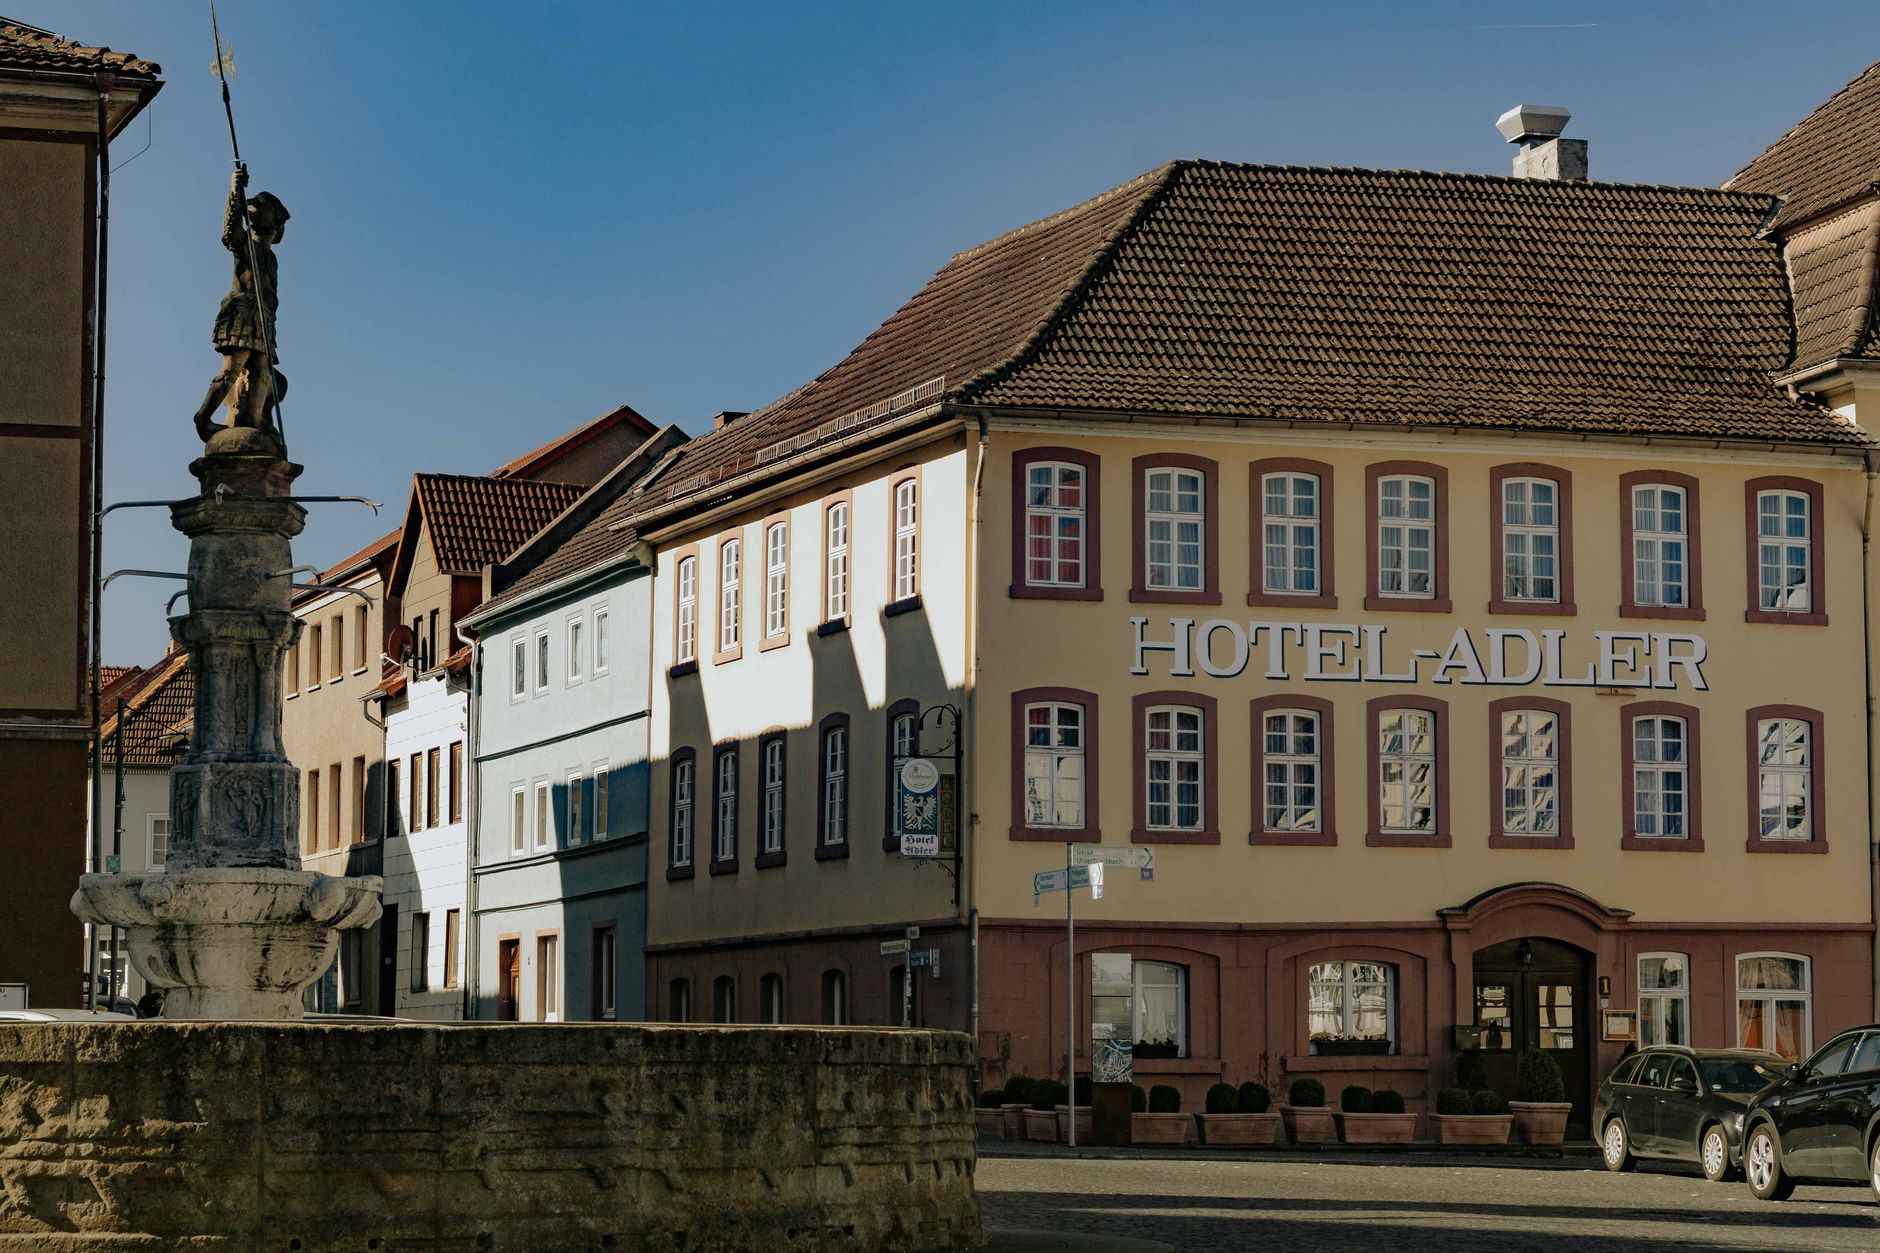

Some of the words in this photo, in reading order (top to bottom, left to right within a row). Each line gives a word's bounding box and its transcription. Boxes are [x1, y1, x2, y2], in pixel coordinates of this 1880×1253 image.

[905, 835, 934, 844] Hotel
[904, 845, 934, 855] Adler
[1602, 978, 1609, 993] 1
